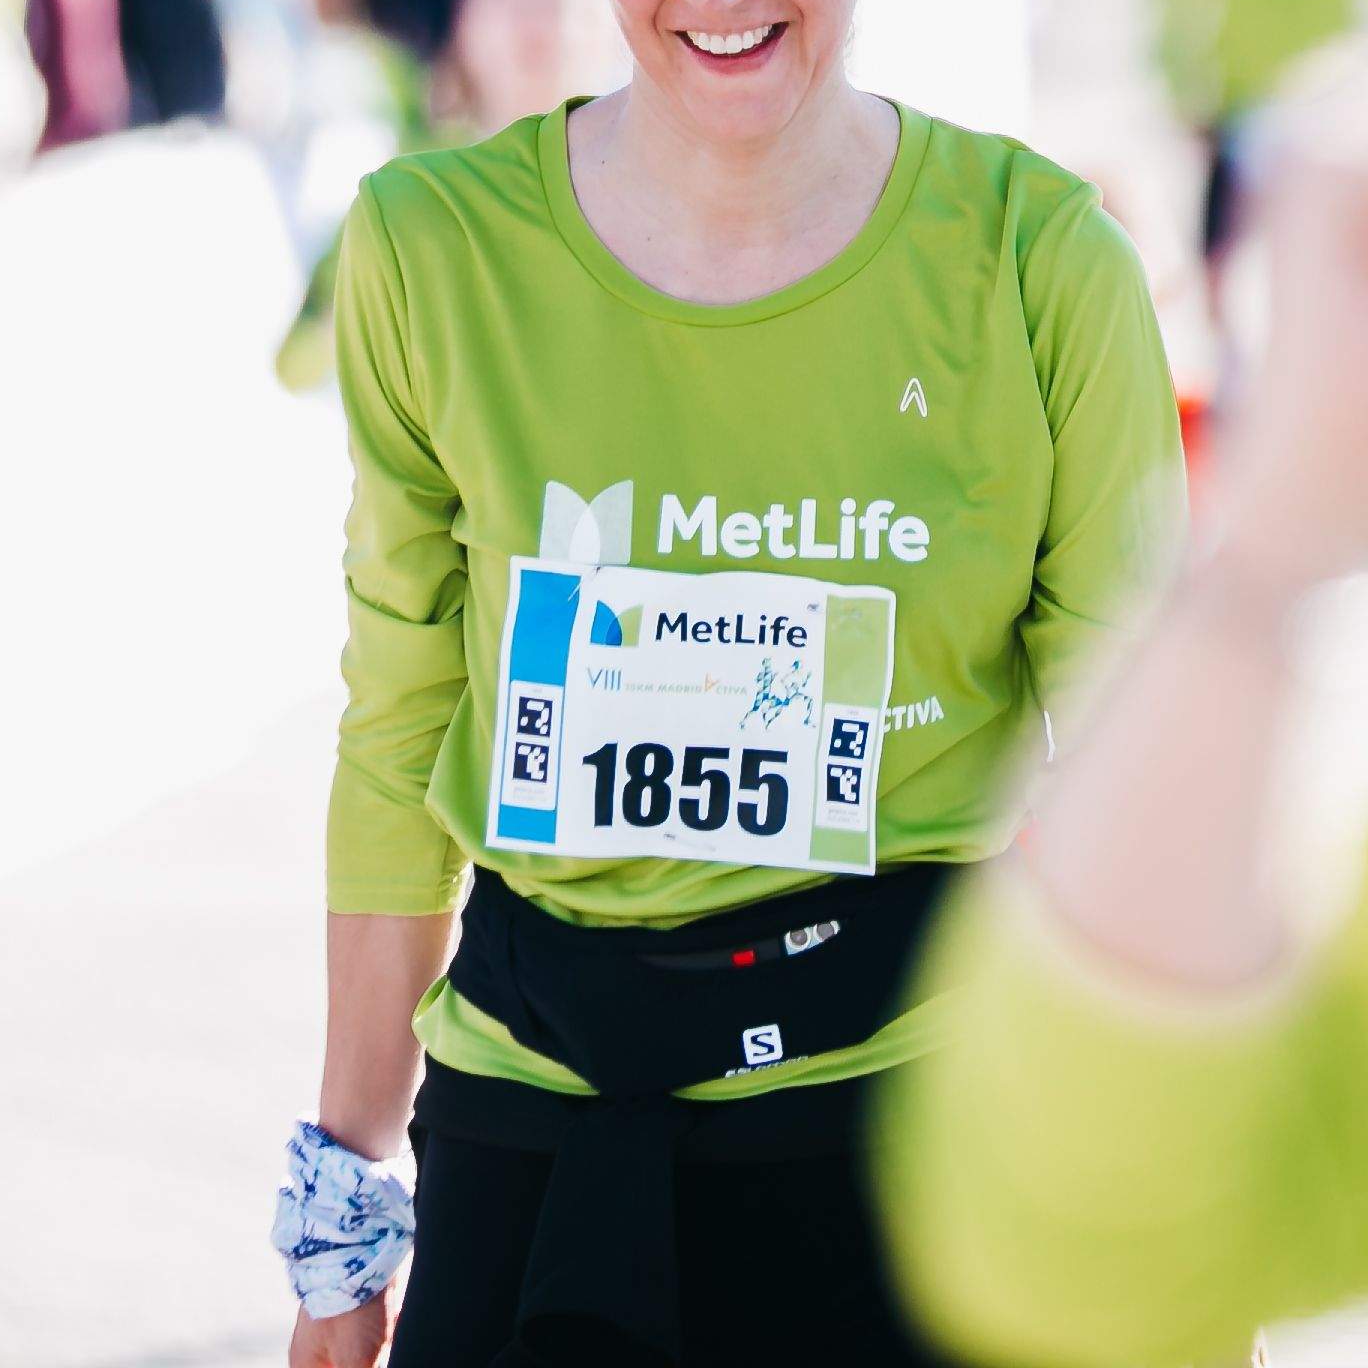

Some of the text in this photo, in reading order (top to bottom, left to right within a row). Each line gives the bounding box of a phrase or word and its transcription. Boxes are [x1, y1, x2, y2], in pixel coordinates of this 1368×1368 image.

[655, 493, 931, 564] MetLife
[655, 612, 808, 648] MetLife
[585, 667, 624, 692] VIII
[883, 696, 945, 733] CTIVA
[582, 742, 789, 837] 1855
